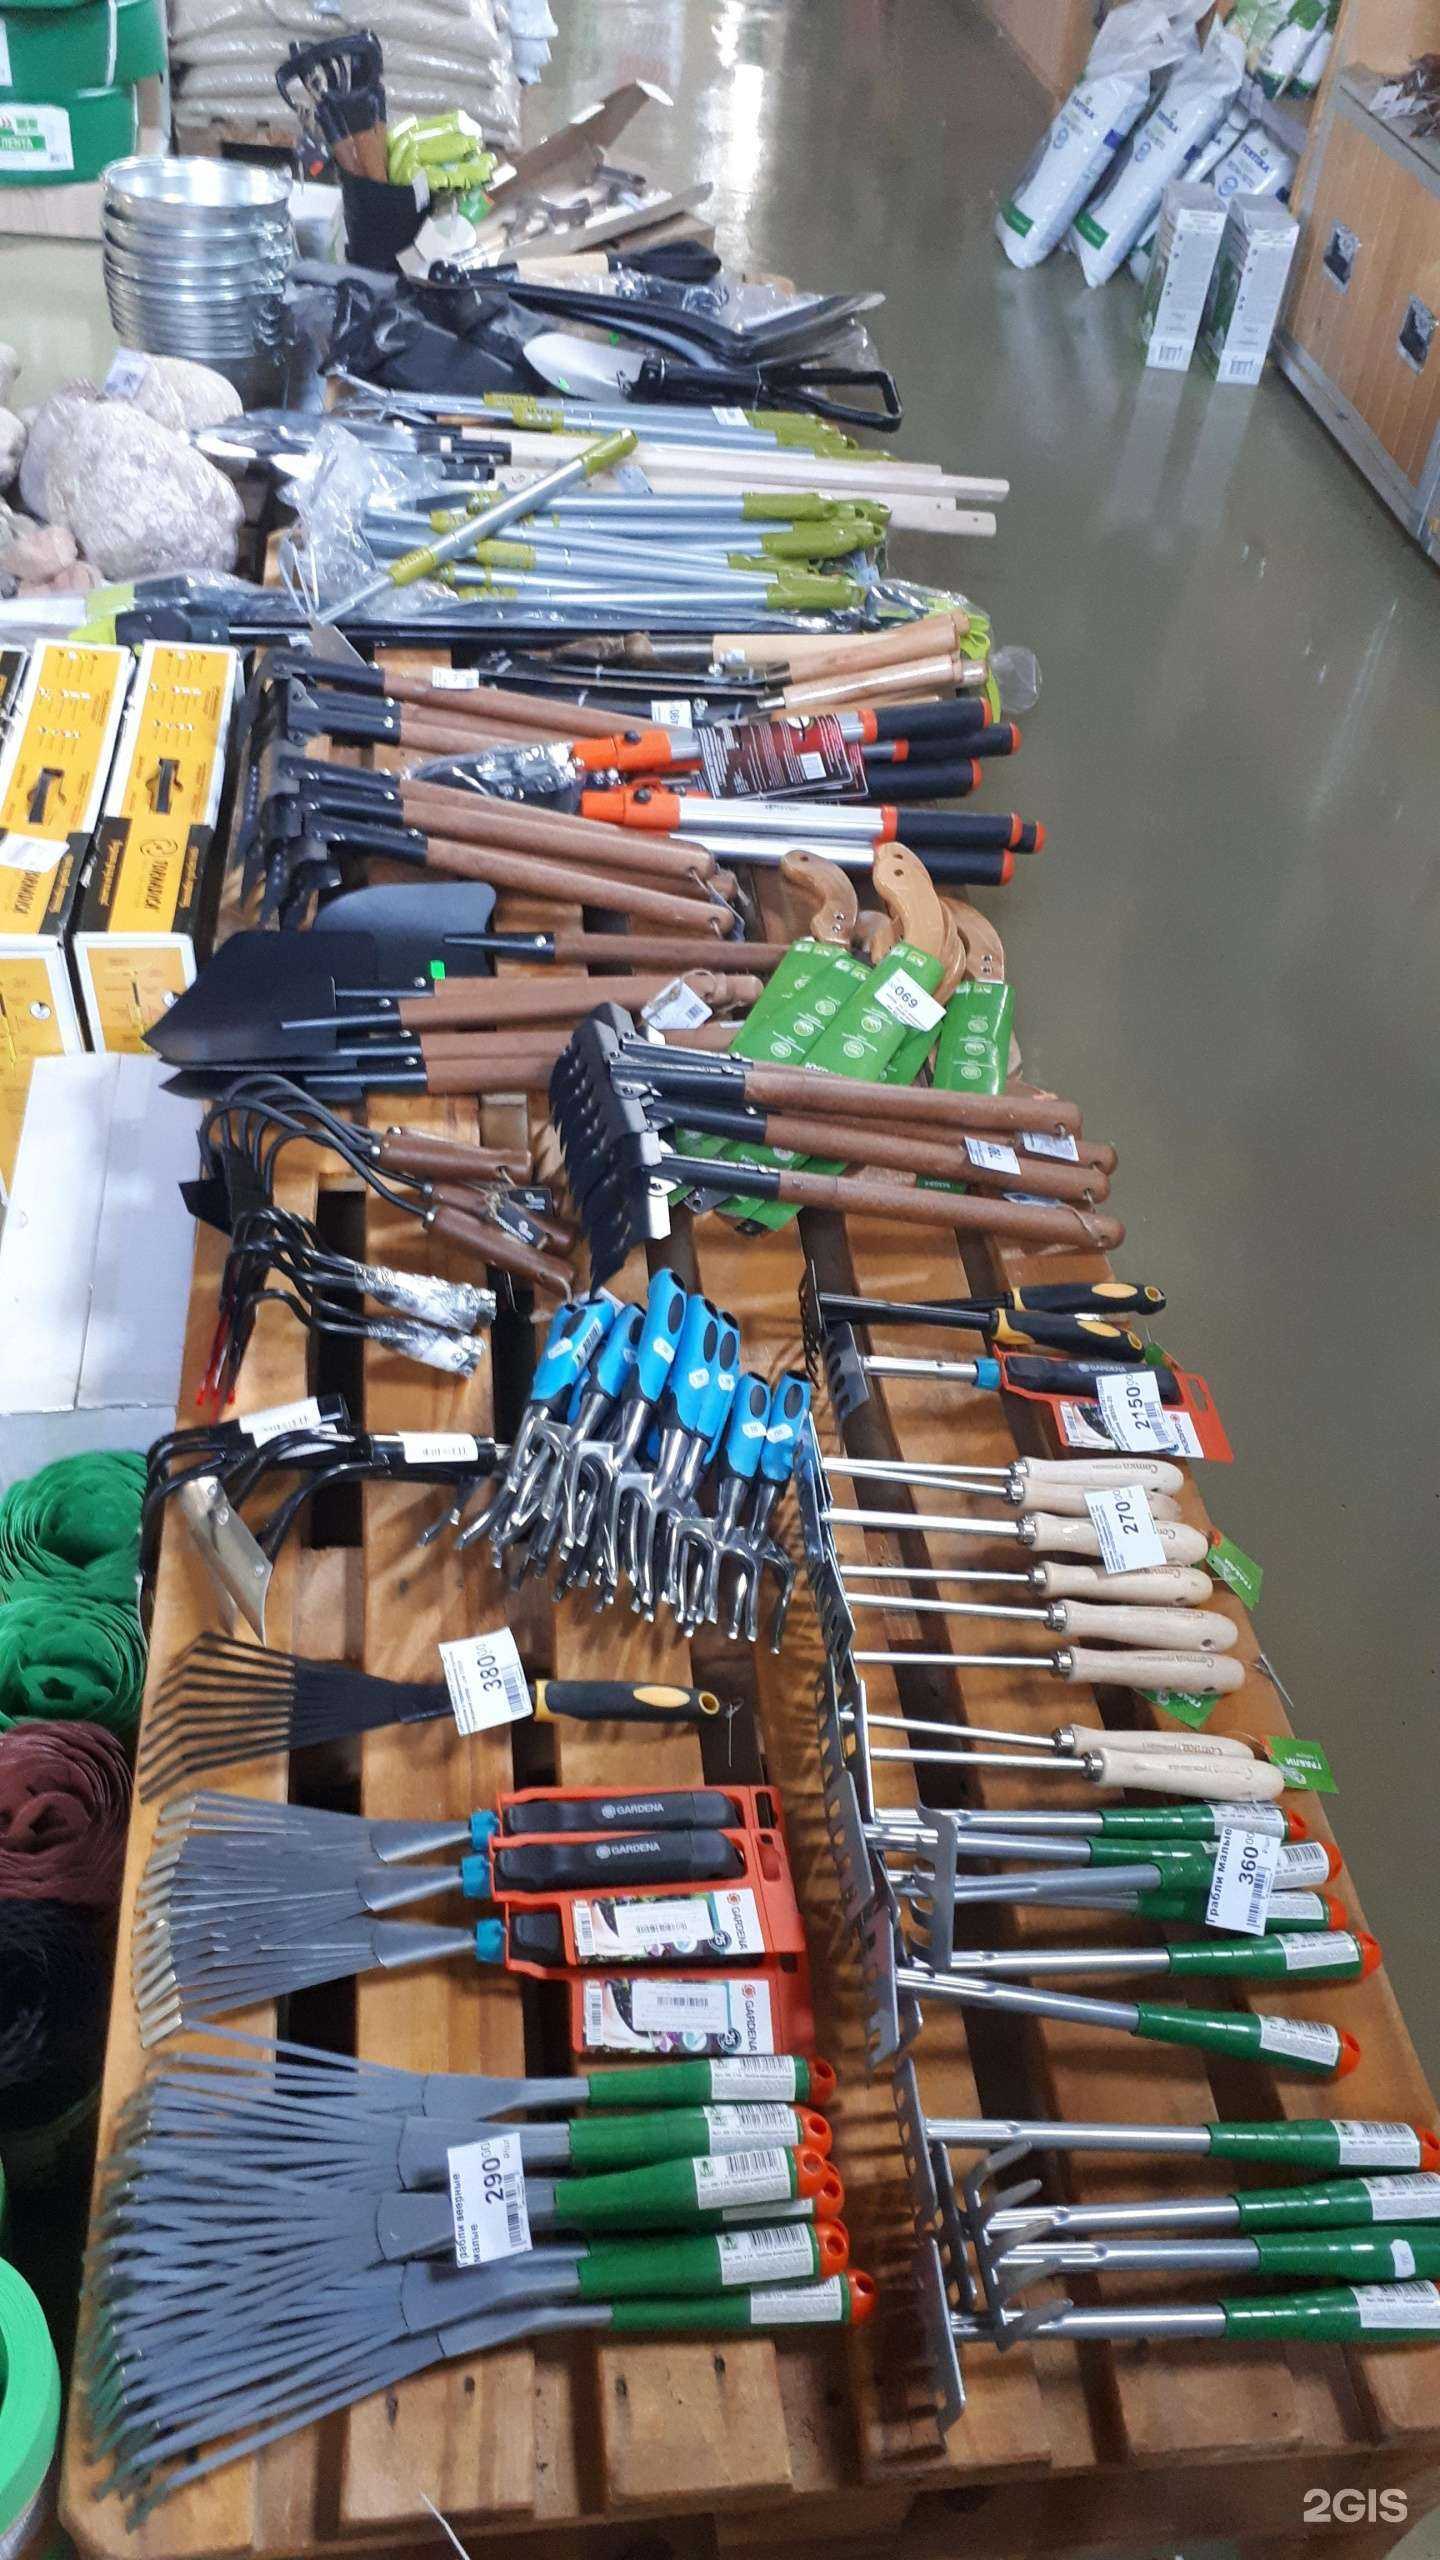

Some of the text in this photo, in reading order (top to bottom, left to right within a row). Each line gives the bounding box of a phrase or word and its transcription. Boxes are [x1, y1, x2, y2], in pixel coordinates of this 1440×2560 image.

[14, 872, 41, 914] ORNADICA
[894, 985, 918, 1008] 690
[1126, 1386, 1151, 1431] 2150
[1115, 1501, 1139, 1535] 270
[476, 1655, 502, 1692] 380
[616, 1803, 665, 1816] GARDENA
[611, 1841, 661, 1855] GARDENA
[1238, 1846, 1259, 1885] 360
[1206, 1827, 1233, 1923] Грабли малые
[731, 1906, 749, 1951] GARDENA
[744, 2000, 758, 2051] GARDENA
[453, 2173, 465, 2222] веерные
[481, 2157, 505, 2204] 290
[470, 2223, 482, 2262] малые
